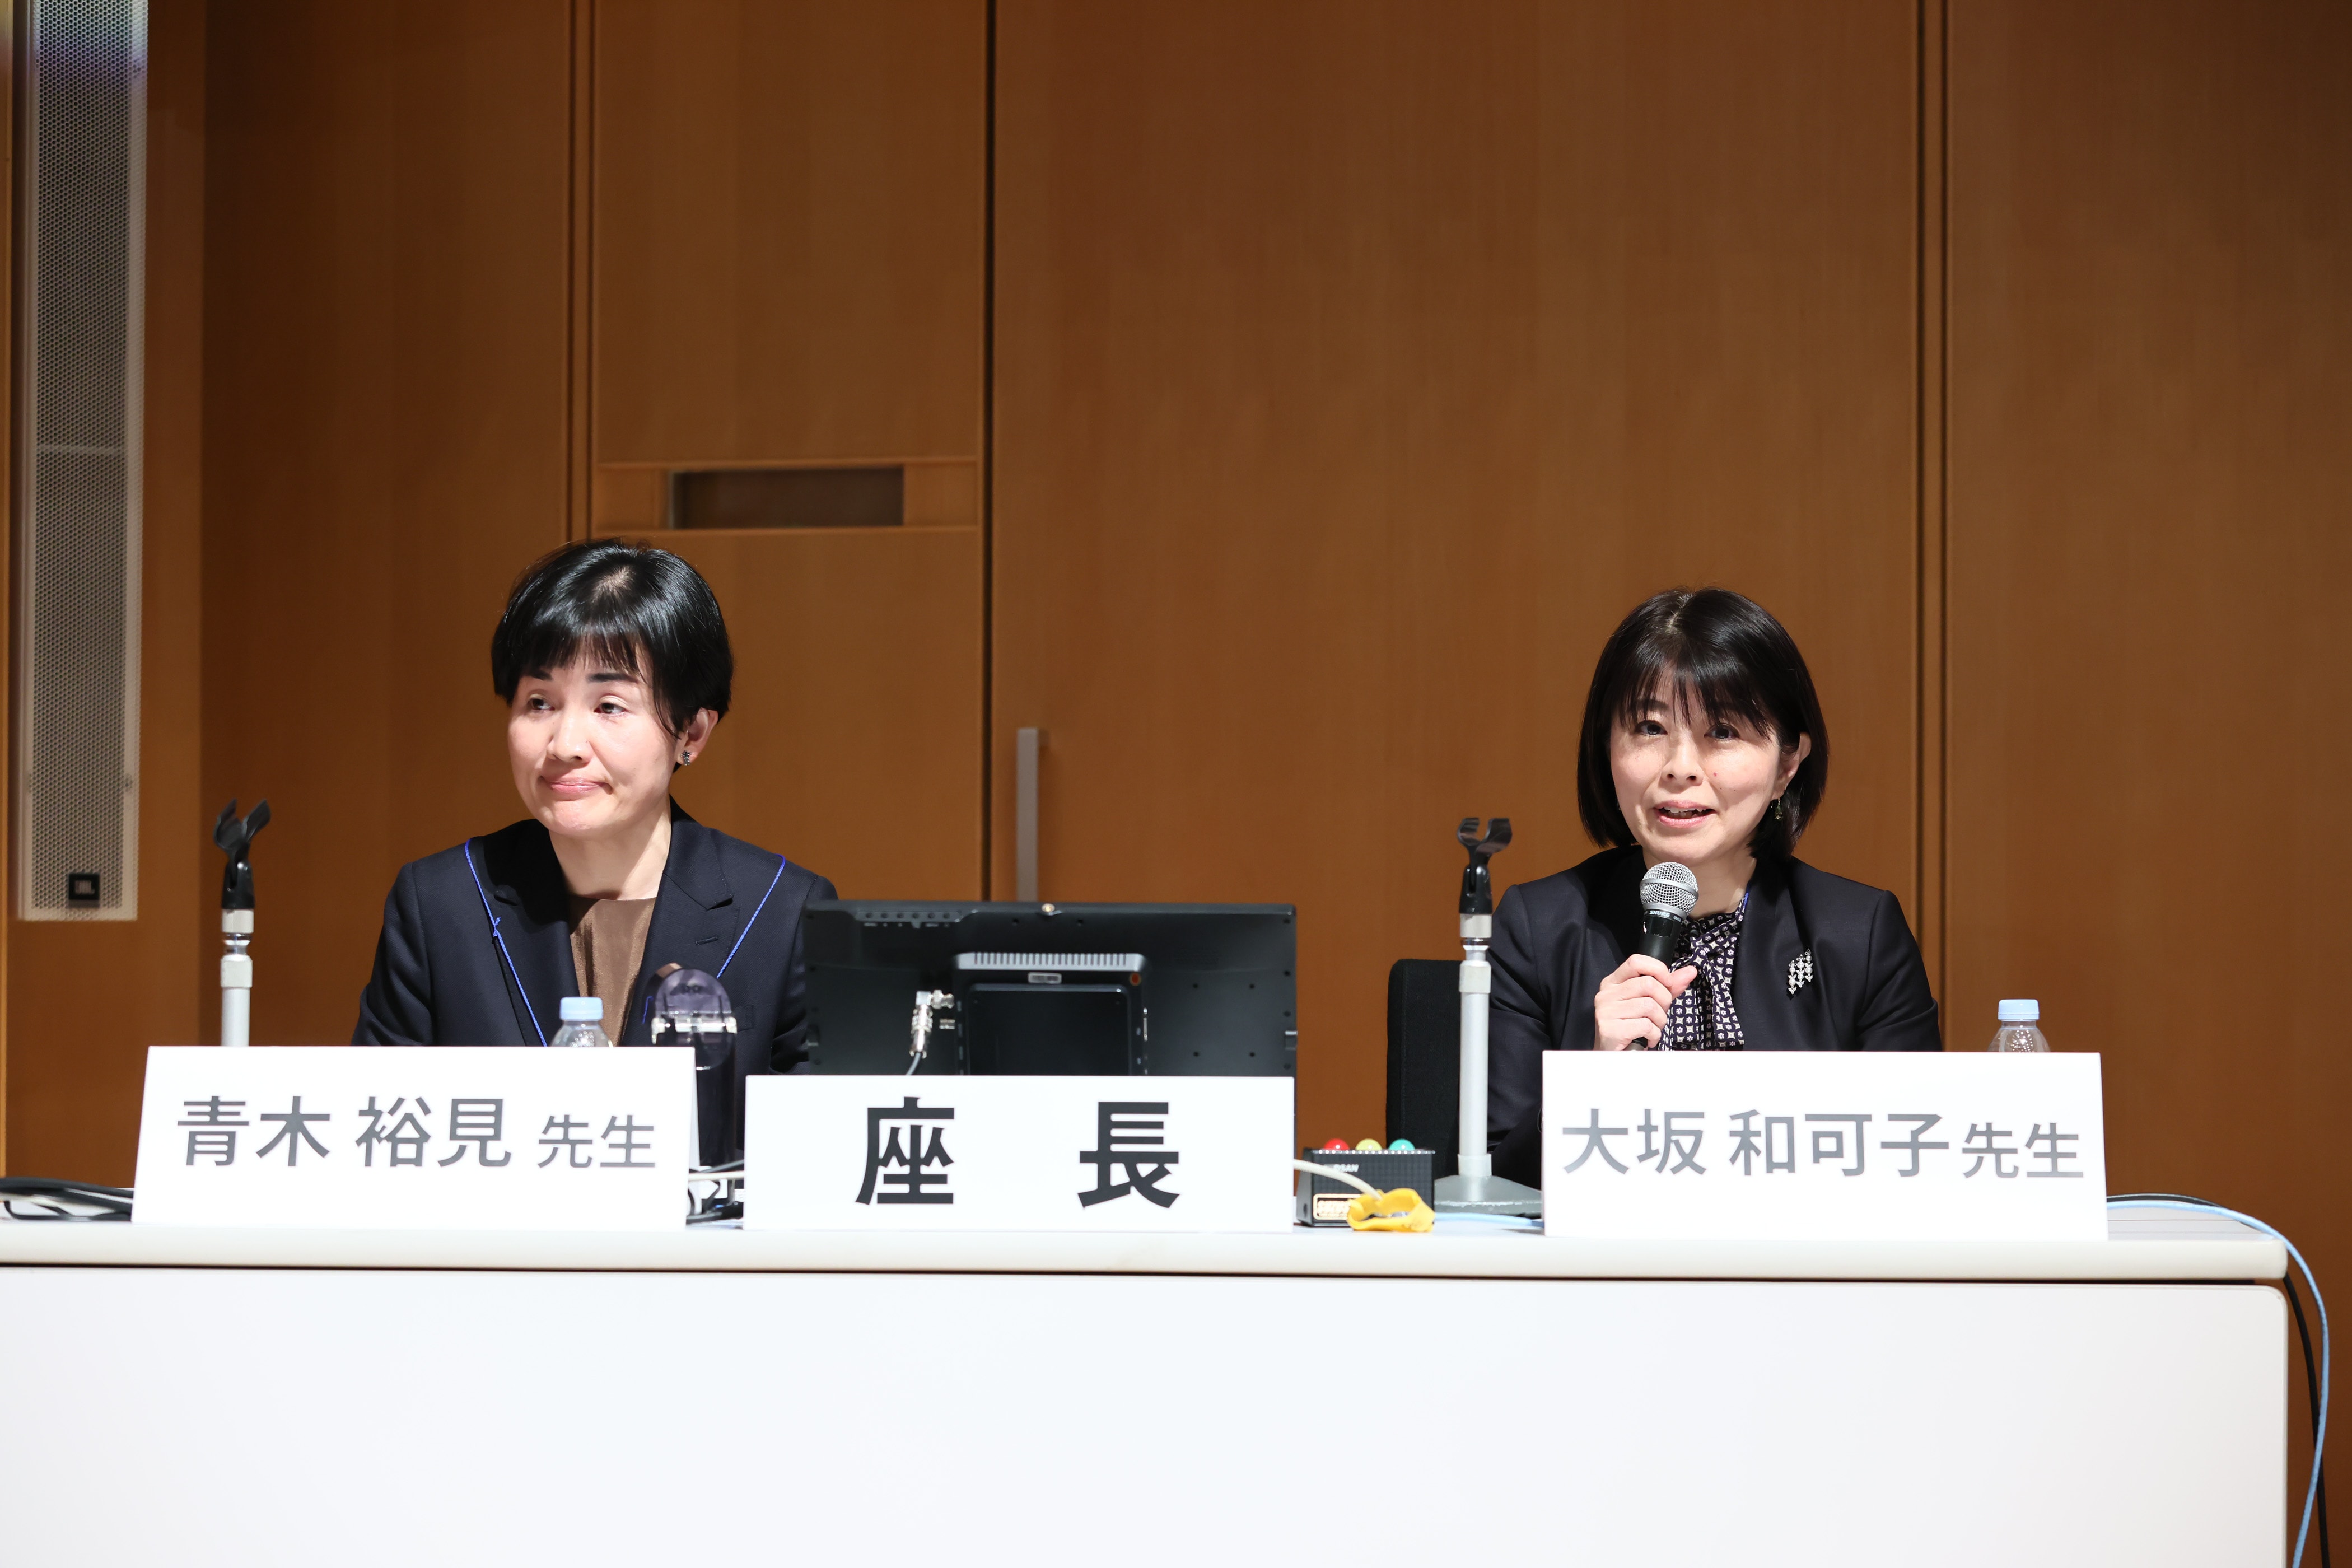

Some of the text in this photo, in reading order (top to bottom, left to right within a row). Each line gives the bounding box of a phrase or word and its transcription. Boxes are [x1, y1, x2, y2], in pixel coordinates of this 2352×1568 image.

[177, 1095, 655, 1168] 青木 裕見 先生
[1563, 1108, 2084, 1179] 大坂 和可子 先生
